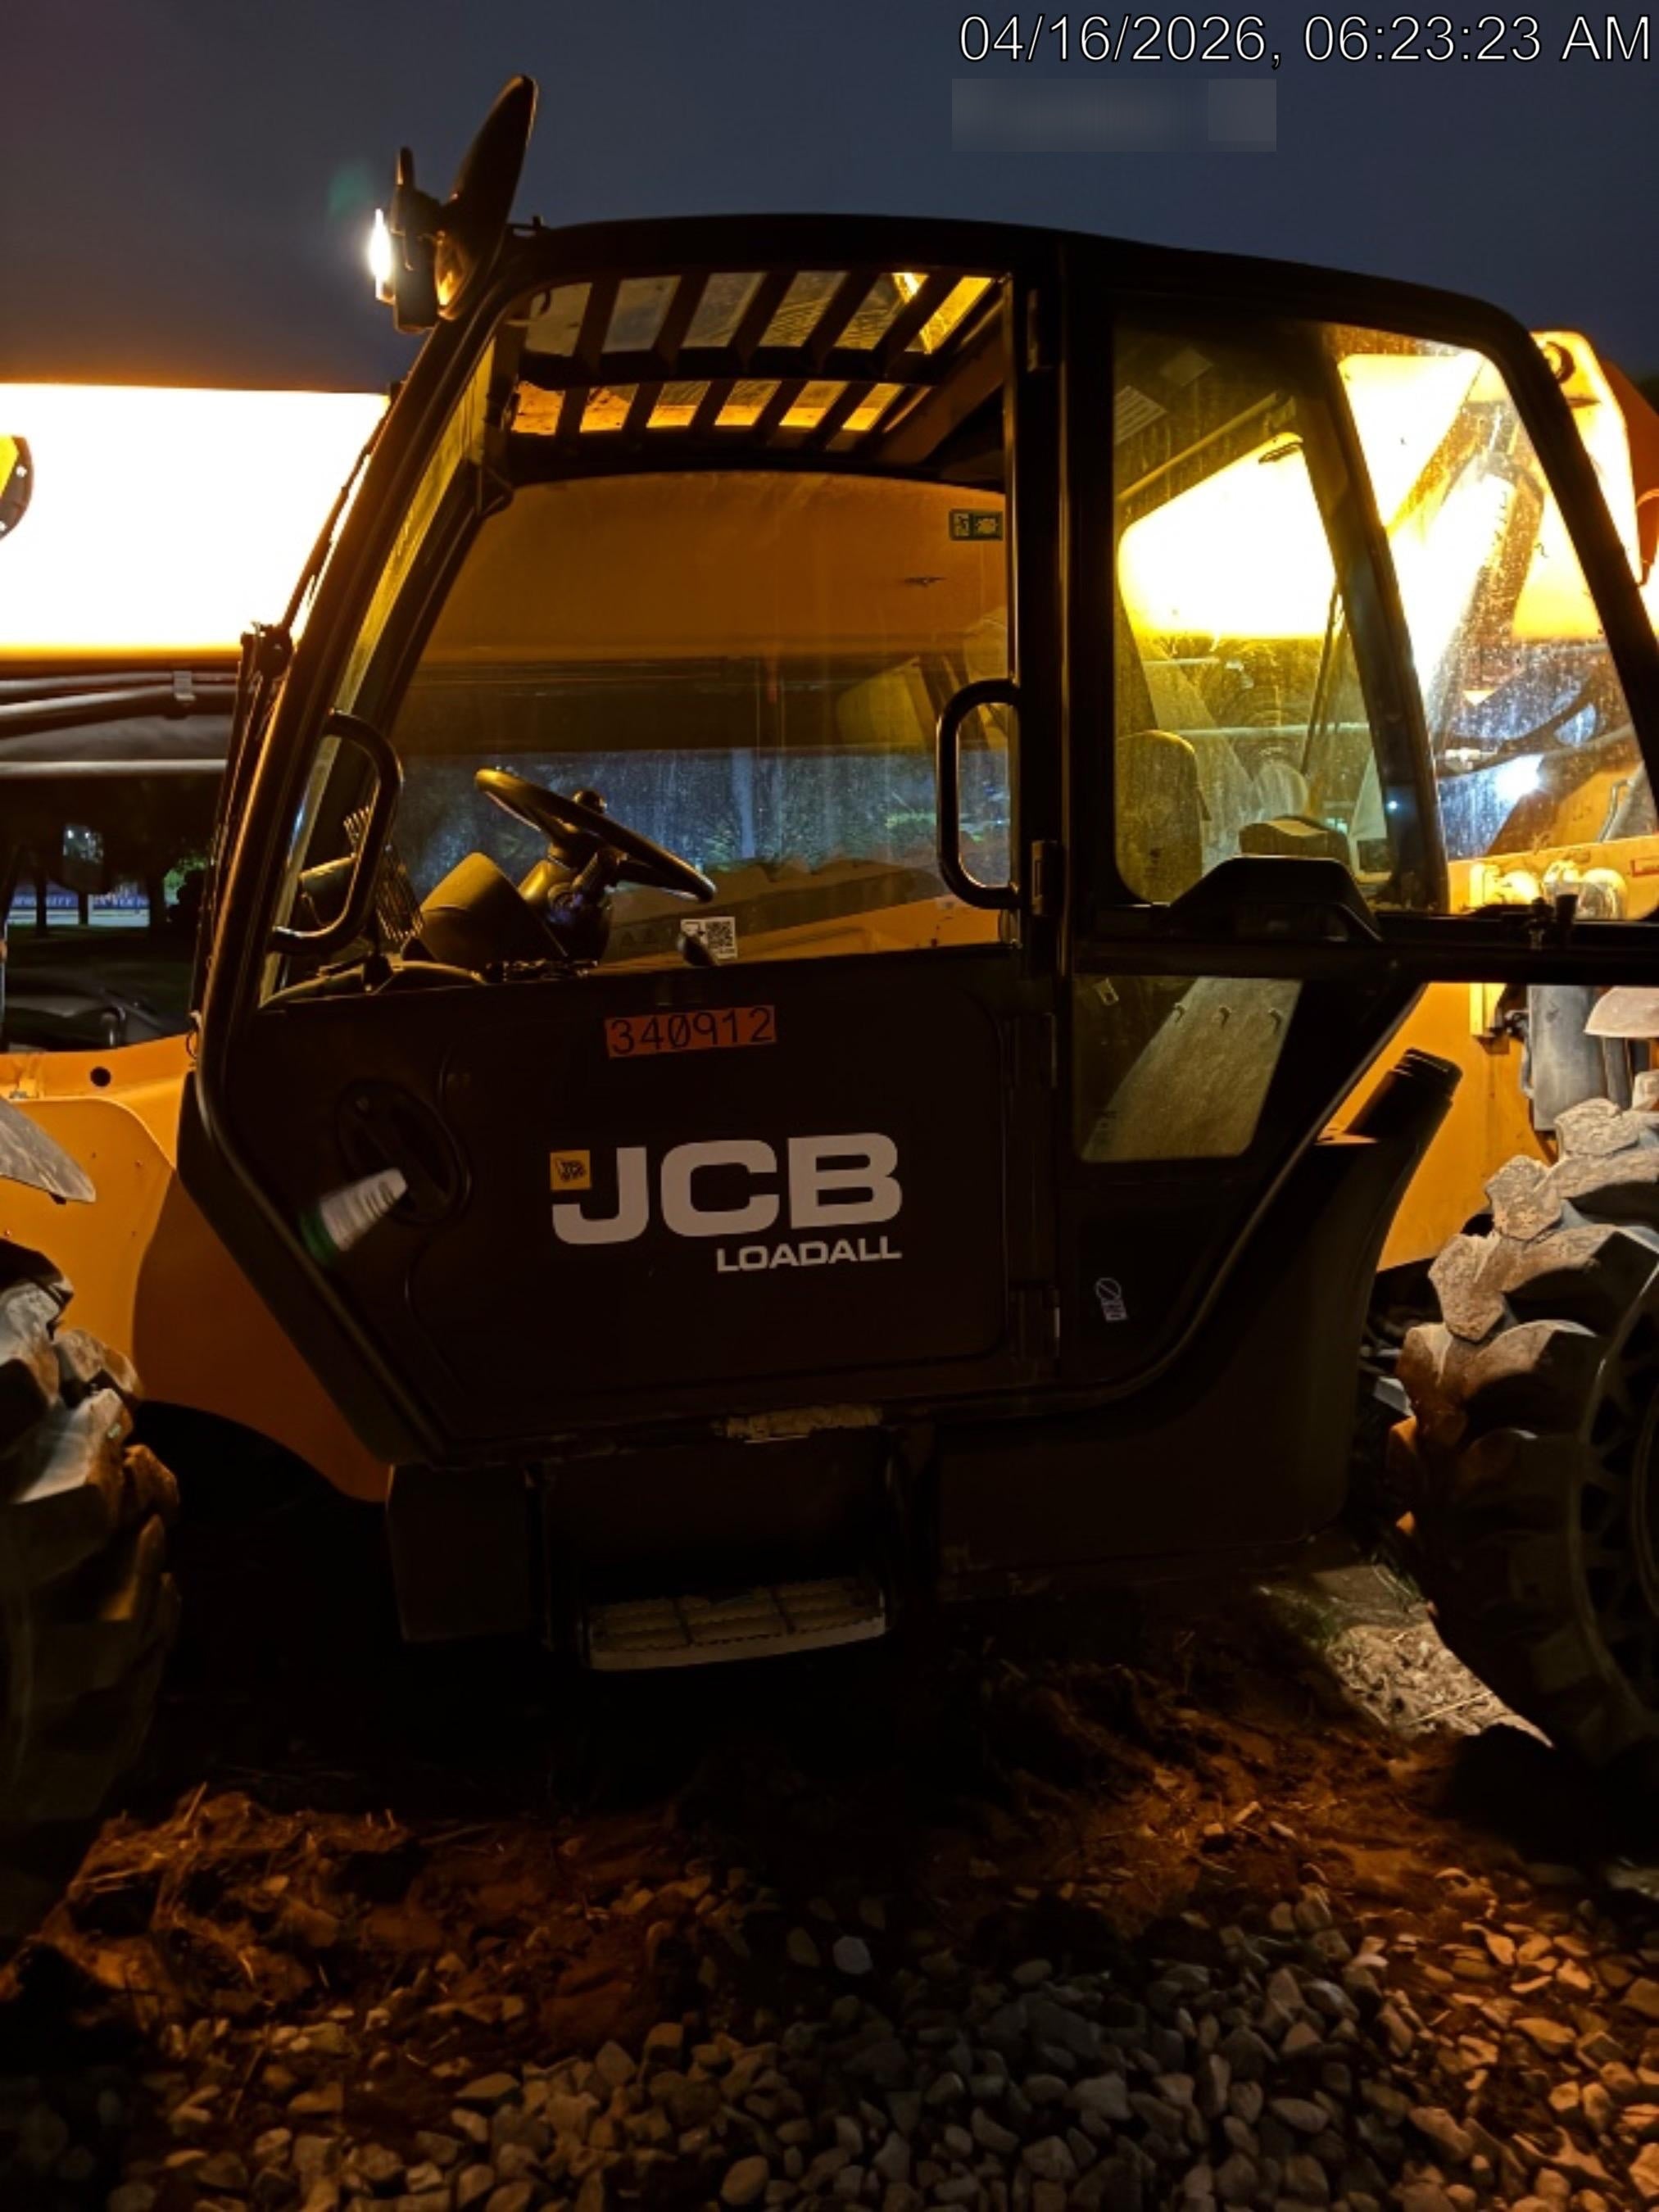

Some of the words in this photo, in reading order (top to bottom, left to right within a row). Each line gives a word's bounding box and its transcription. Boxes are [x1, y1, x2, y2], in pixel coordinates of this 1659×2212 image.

[610, 1007, 773, 1054] 340912
[551, 1132, 902, 1244] JCB
[716, 1236, 902, 1272] LOADALL
